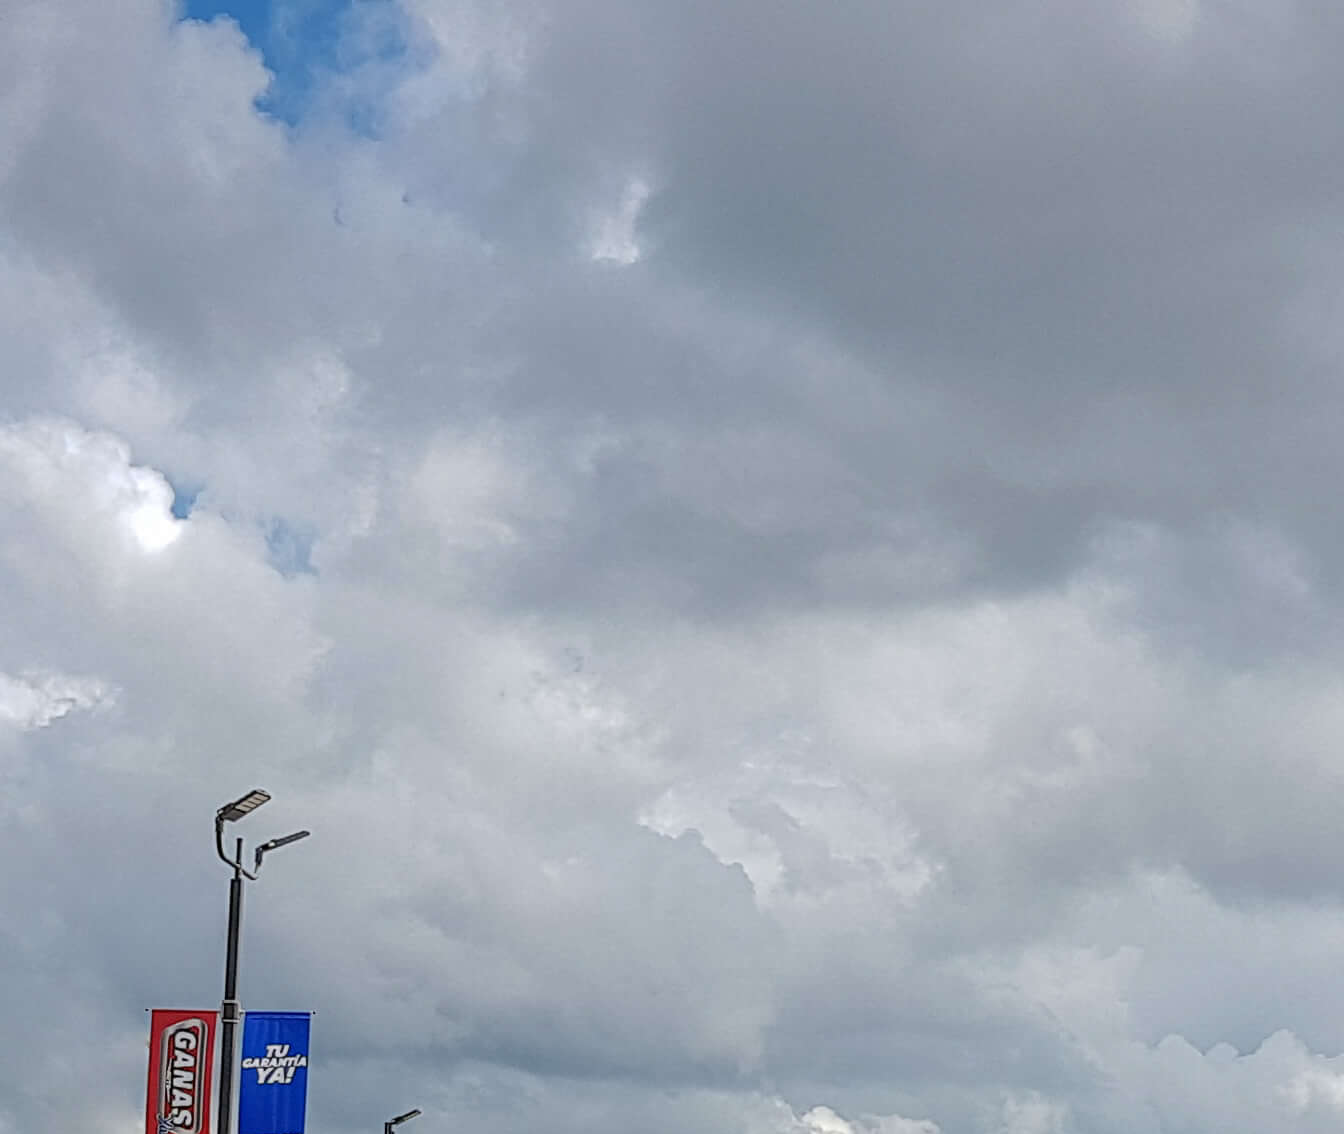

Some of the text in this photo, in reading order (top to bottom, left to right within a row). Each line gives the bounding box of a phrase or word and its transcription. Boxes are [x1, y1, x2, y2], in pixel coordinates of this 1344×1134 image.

[265, 1044, 290, 1058] TU
[170, 1029, 197, 1128] GANAS
[256, 1066, 296, 1085] YA!
